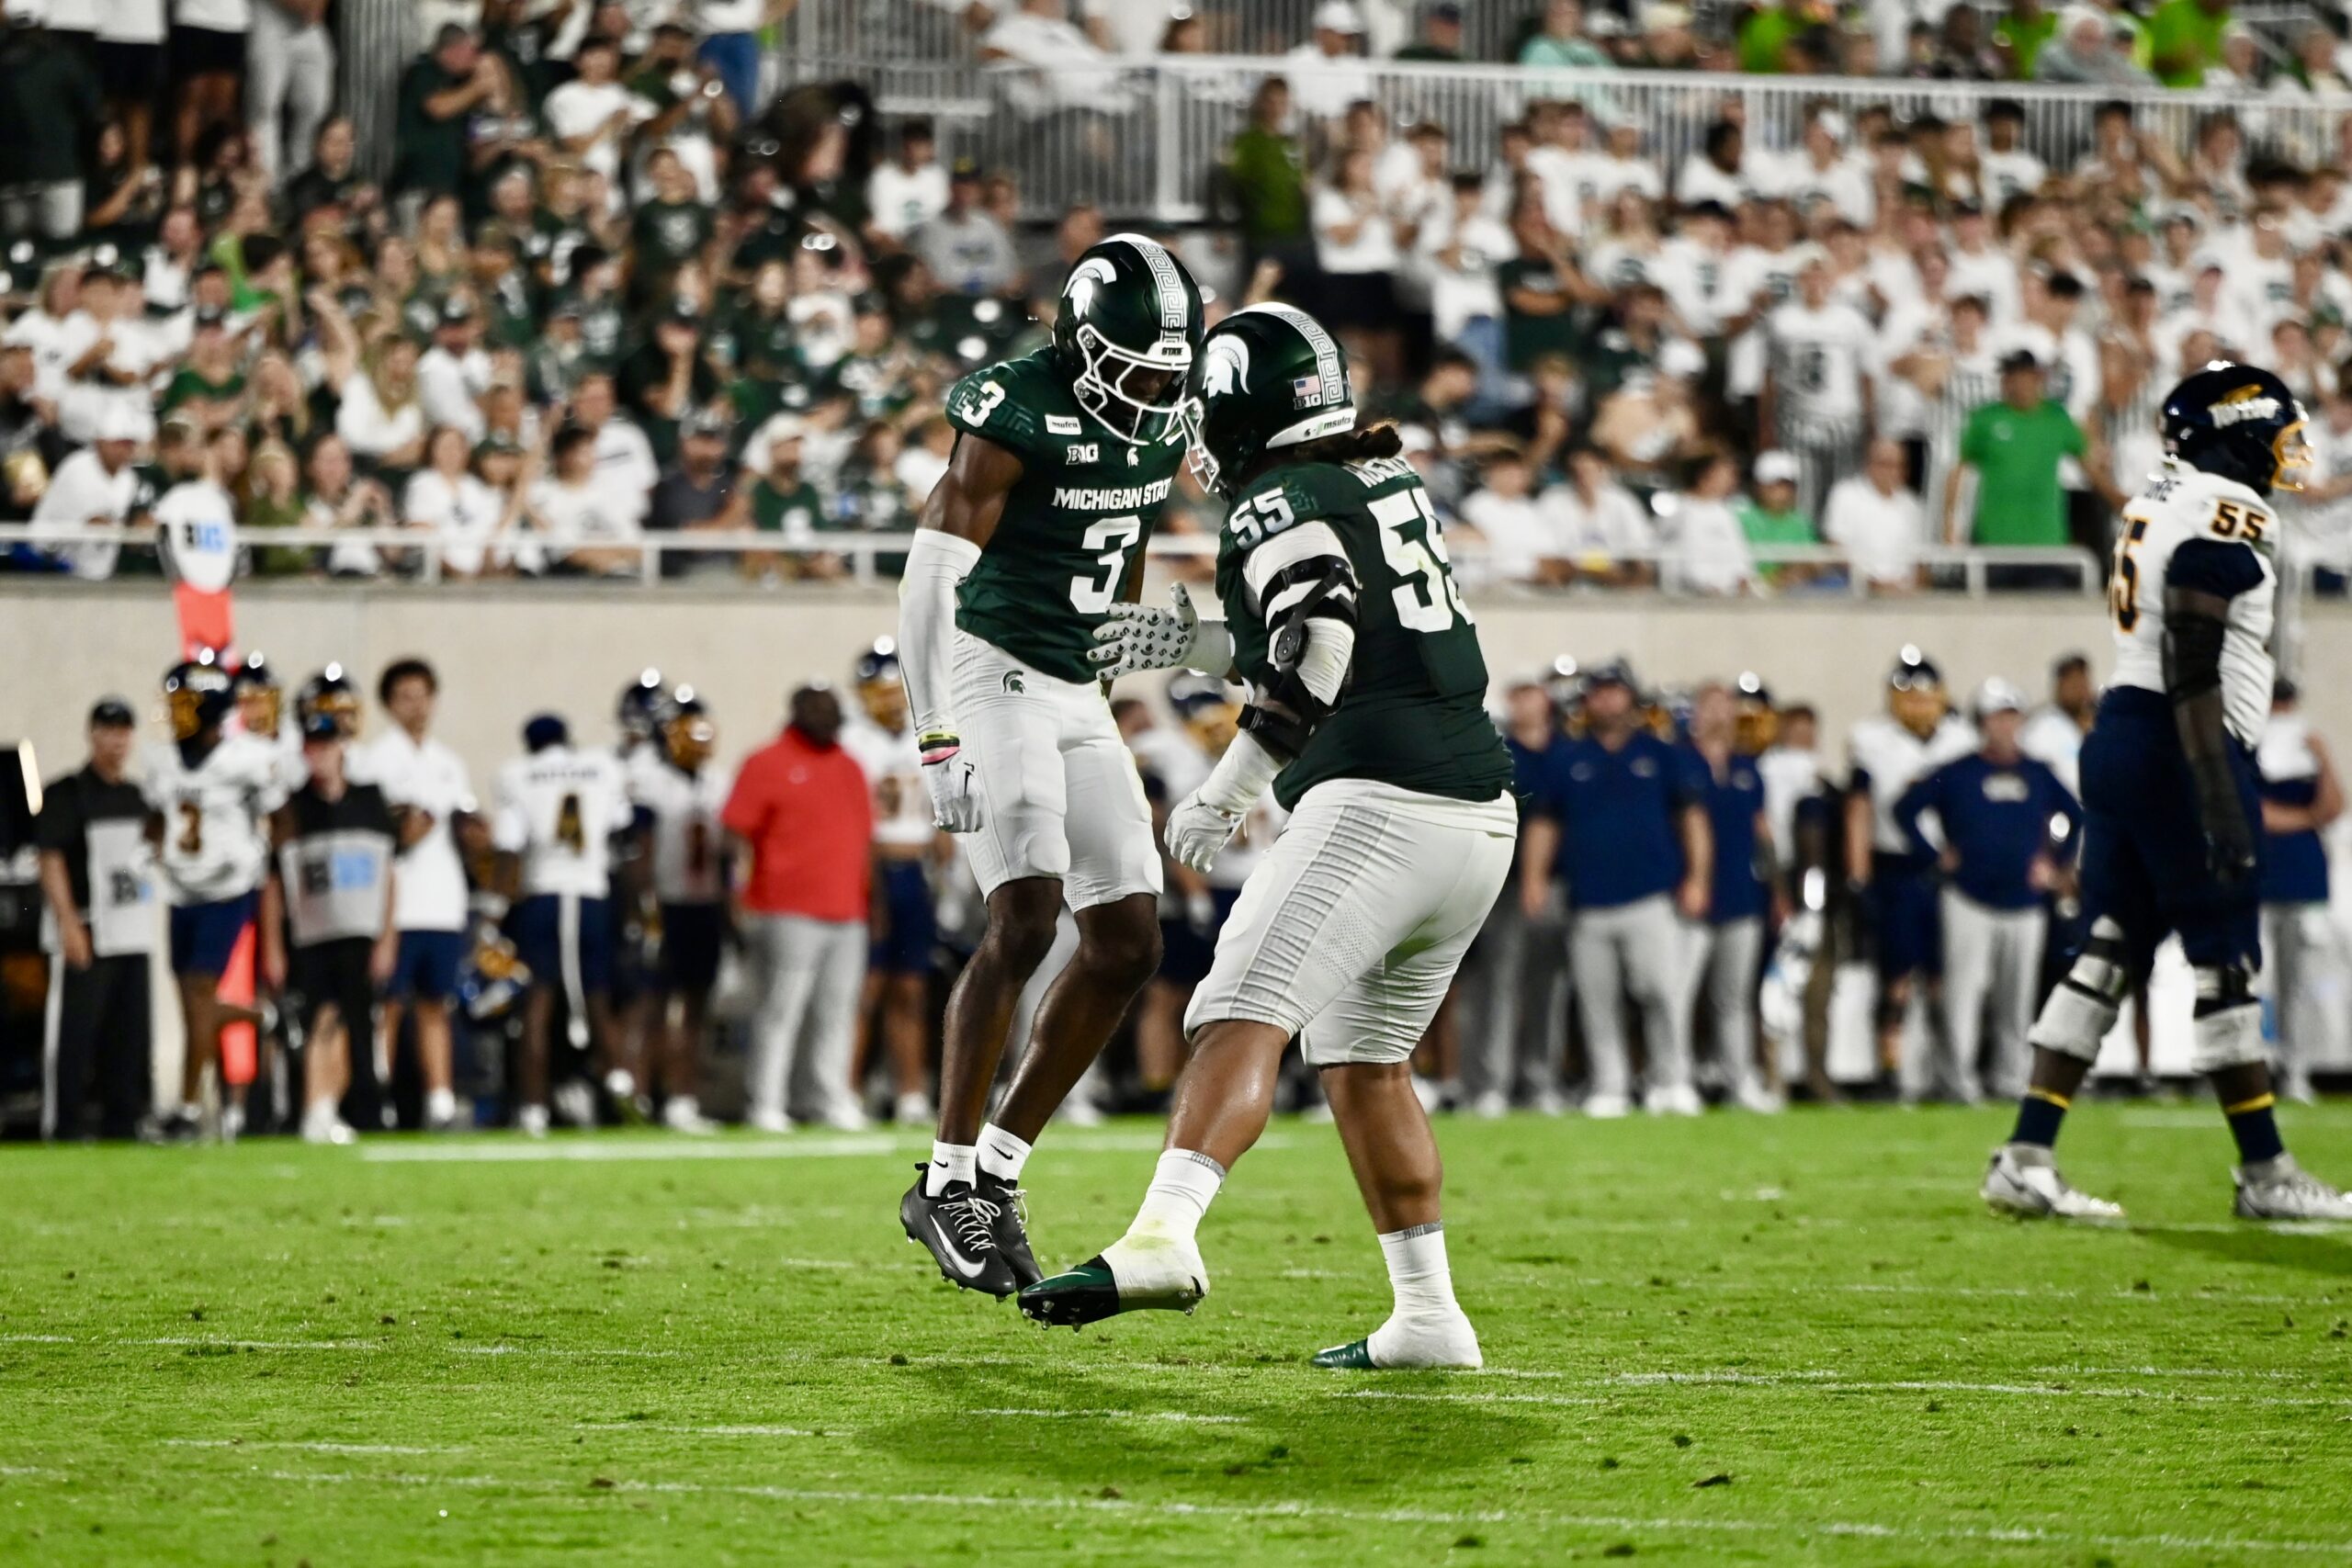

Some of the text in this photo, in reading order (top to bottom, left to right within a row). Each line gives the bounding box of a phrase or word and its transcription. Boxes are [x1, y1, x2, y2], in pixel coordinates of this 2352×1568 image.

[962, 380, 1006, 428] 3
[1050, 476, 1173, 511] MICHIGAN STAT
[1229, 486, 1295, 550] 55
[2211, 501, 2267, 543] 55
[1069, 514, 1141, 615] 3
